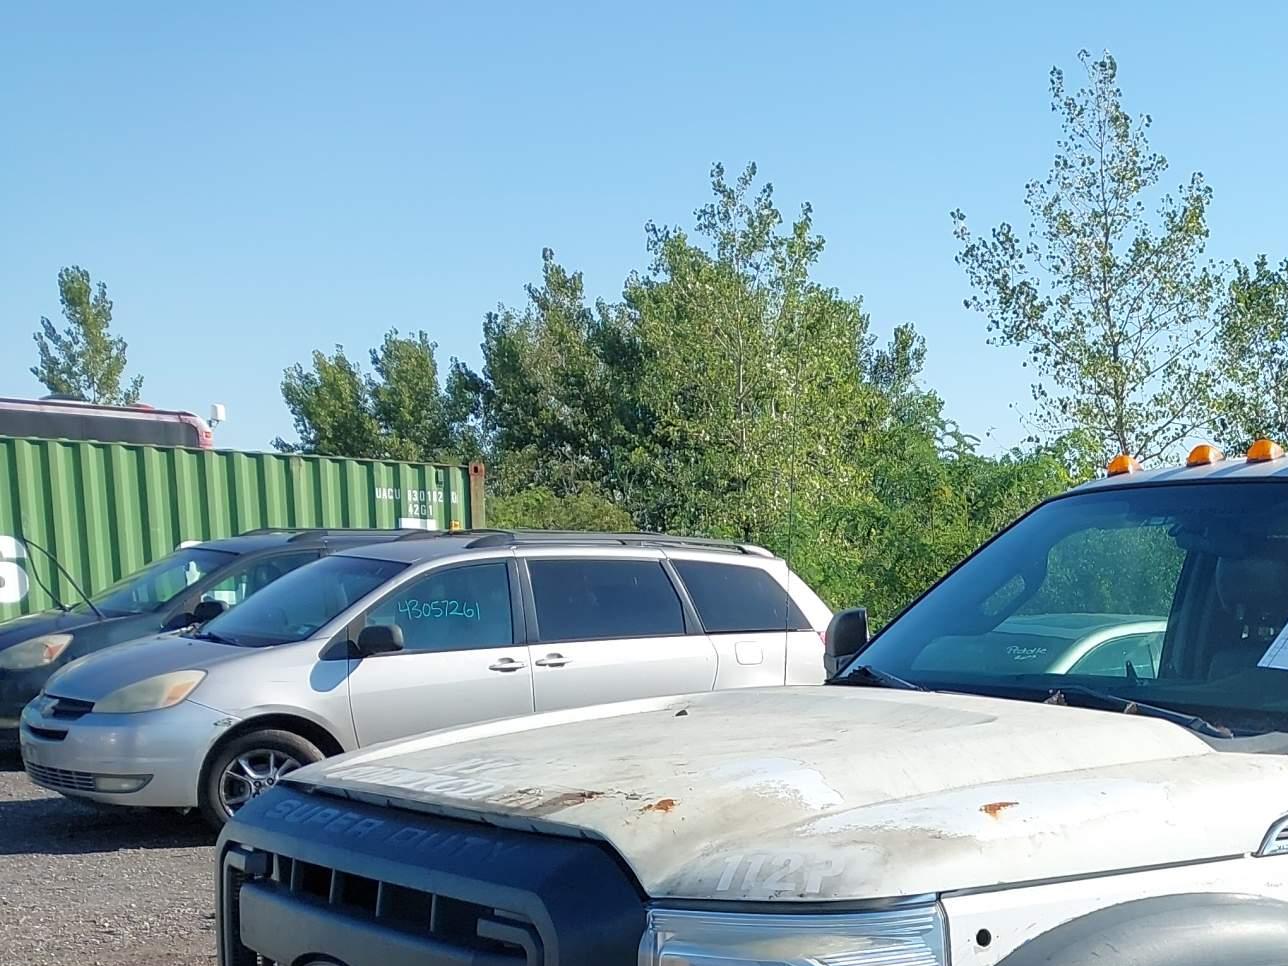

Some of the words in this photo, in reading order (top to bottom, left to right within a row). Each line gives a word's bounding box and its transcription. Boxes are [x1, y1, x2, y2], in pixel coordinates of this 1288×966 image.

[408, 504, 433, 516] 42G1
[398, 600, 480, 620] 43057261
[264, 799, 385, 838] SUPER
[384, 827, 521, 863] DUTY
